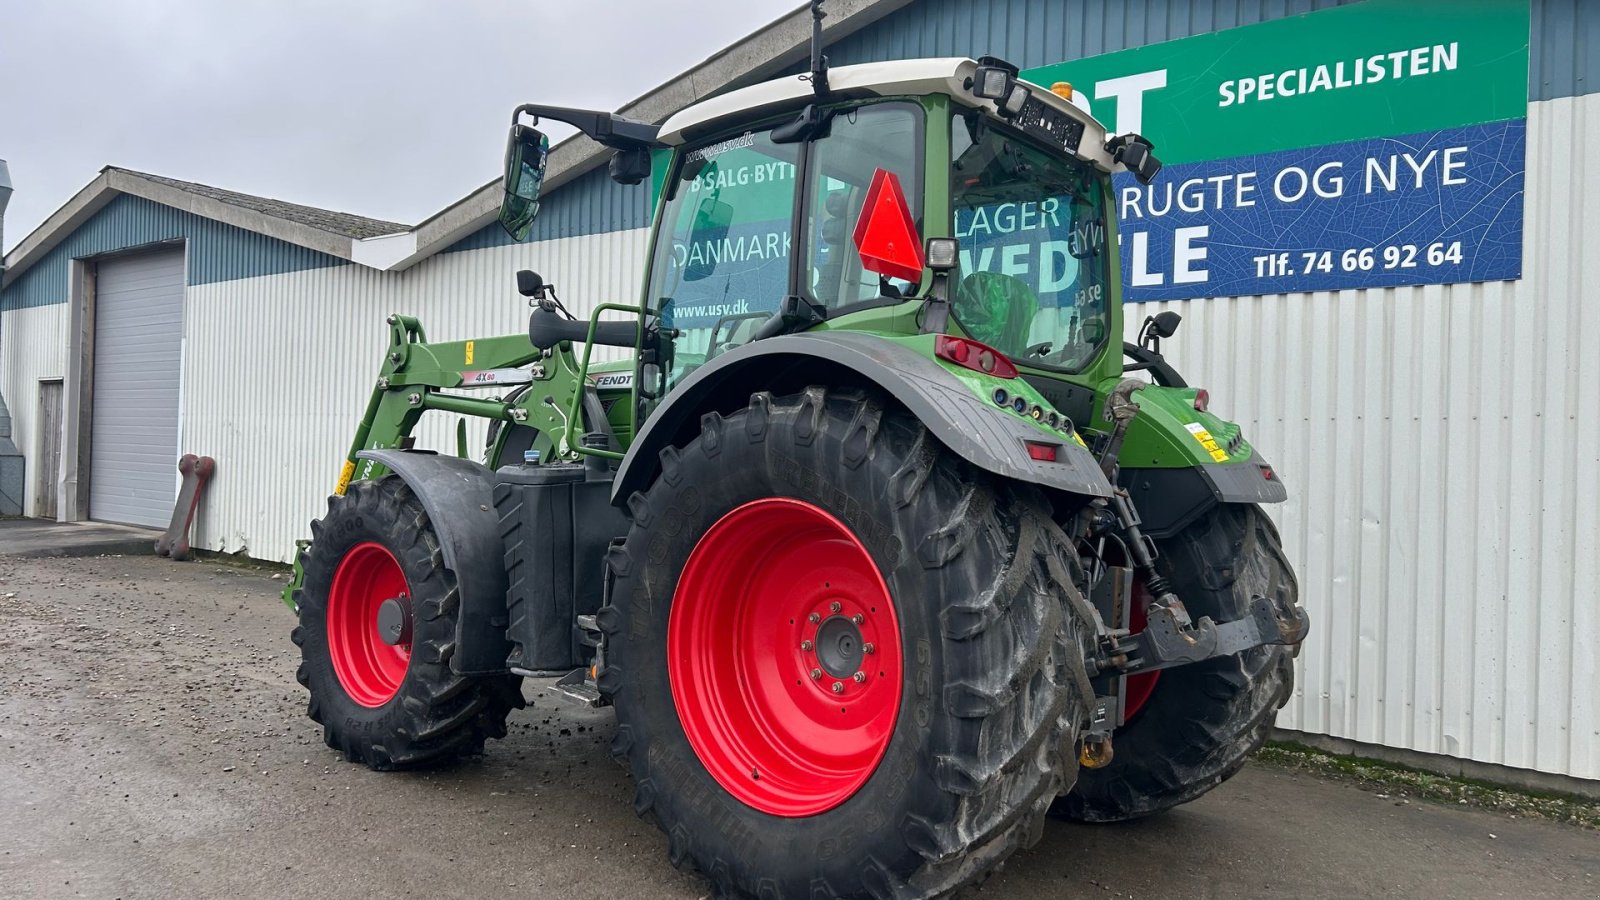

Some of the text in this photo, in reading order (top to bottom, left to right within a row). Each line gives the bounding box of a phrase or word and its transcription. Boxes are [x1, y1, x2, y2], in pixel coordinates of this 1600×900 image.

[1219, 43, 1458, 107] SPECIALISTEN
[672, 146, 1468, 268] DANMARK LAGER RUGTE OG NYE
[673, 241, 1463, 318] www.usv.dk Tlf. 74 66 92 64
[596, 375, 633, 386] FENDT
